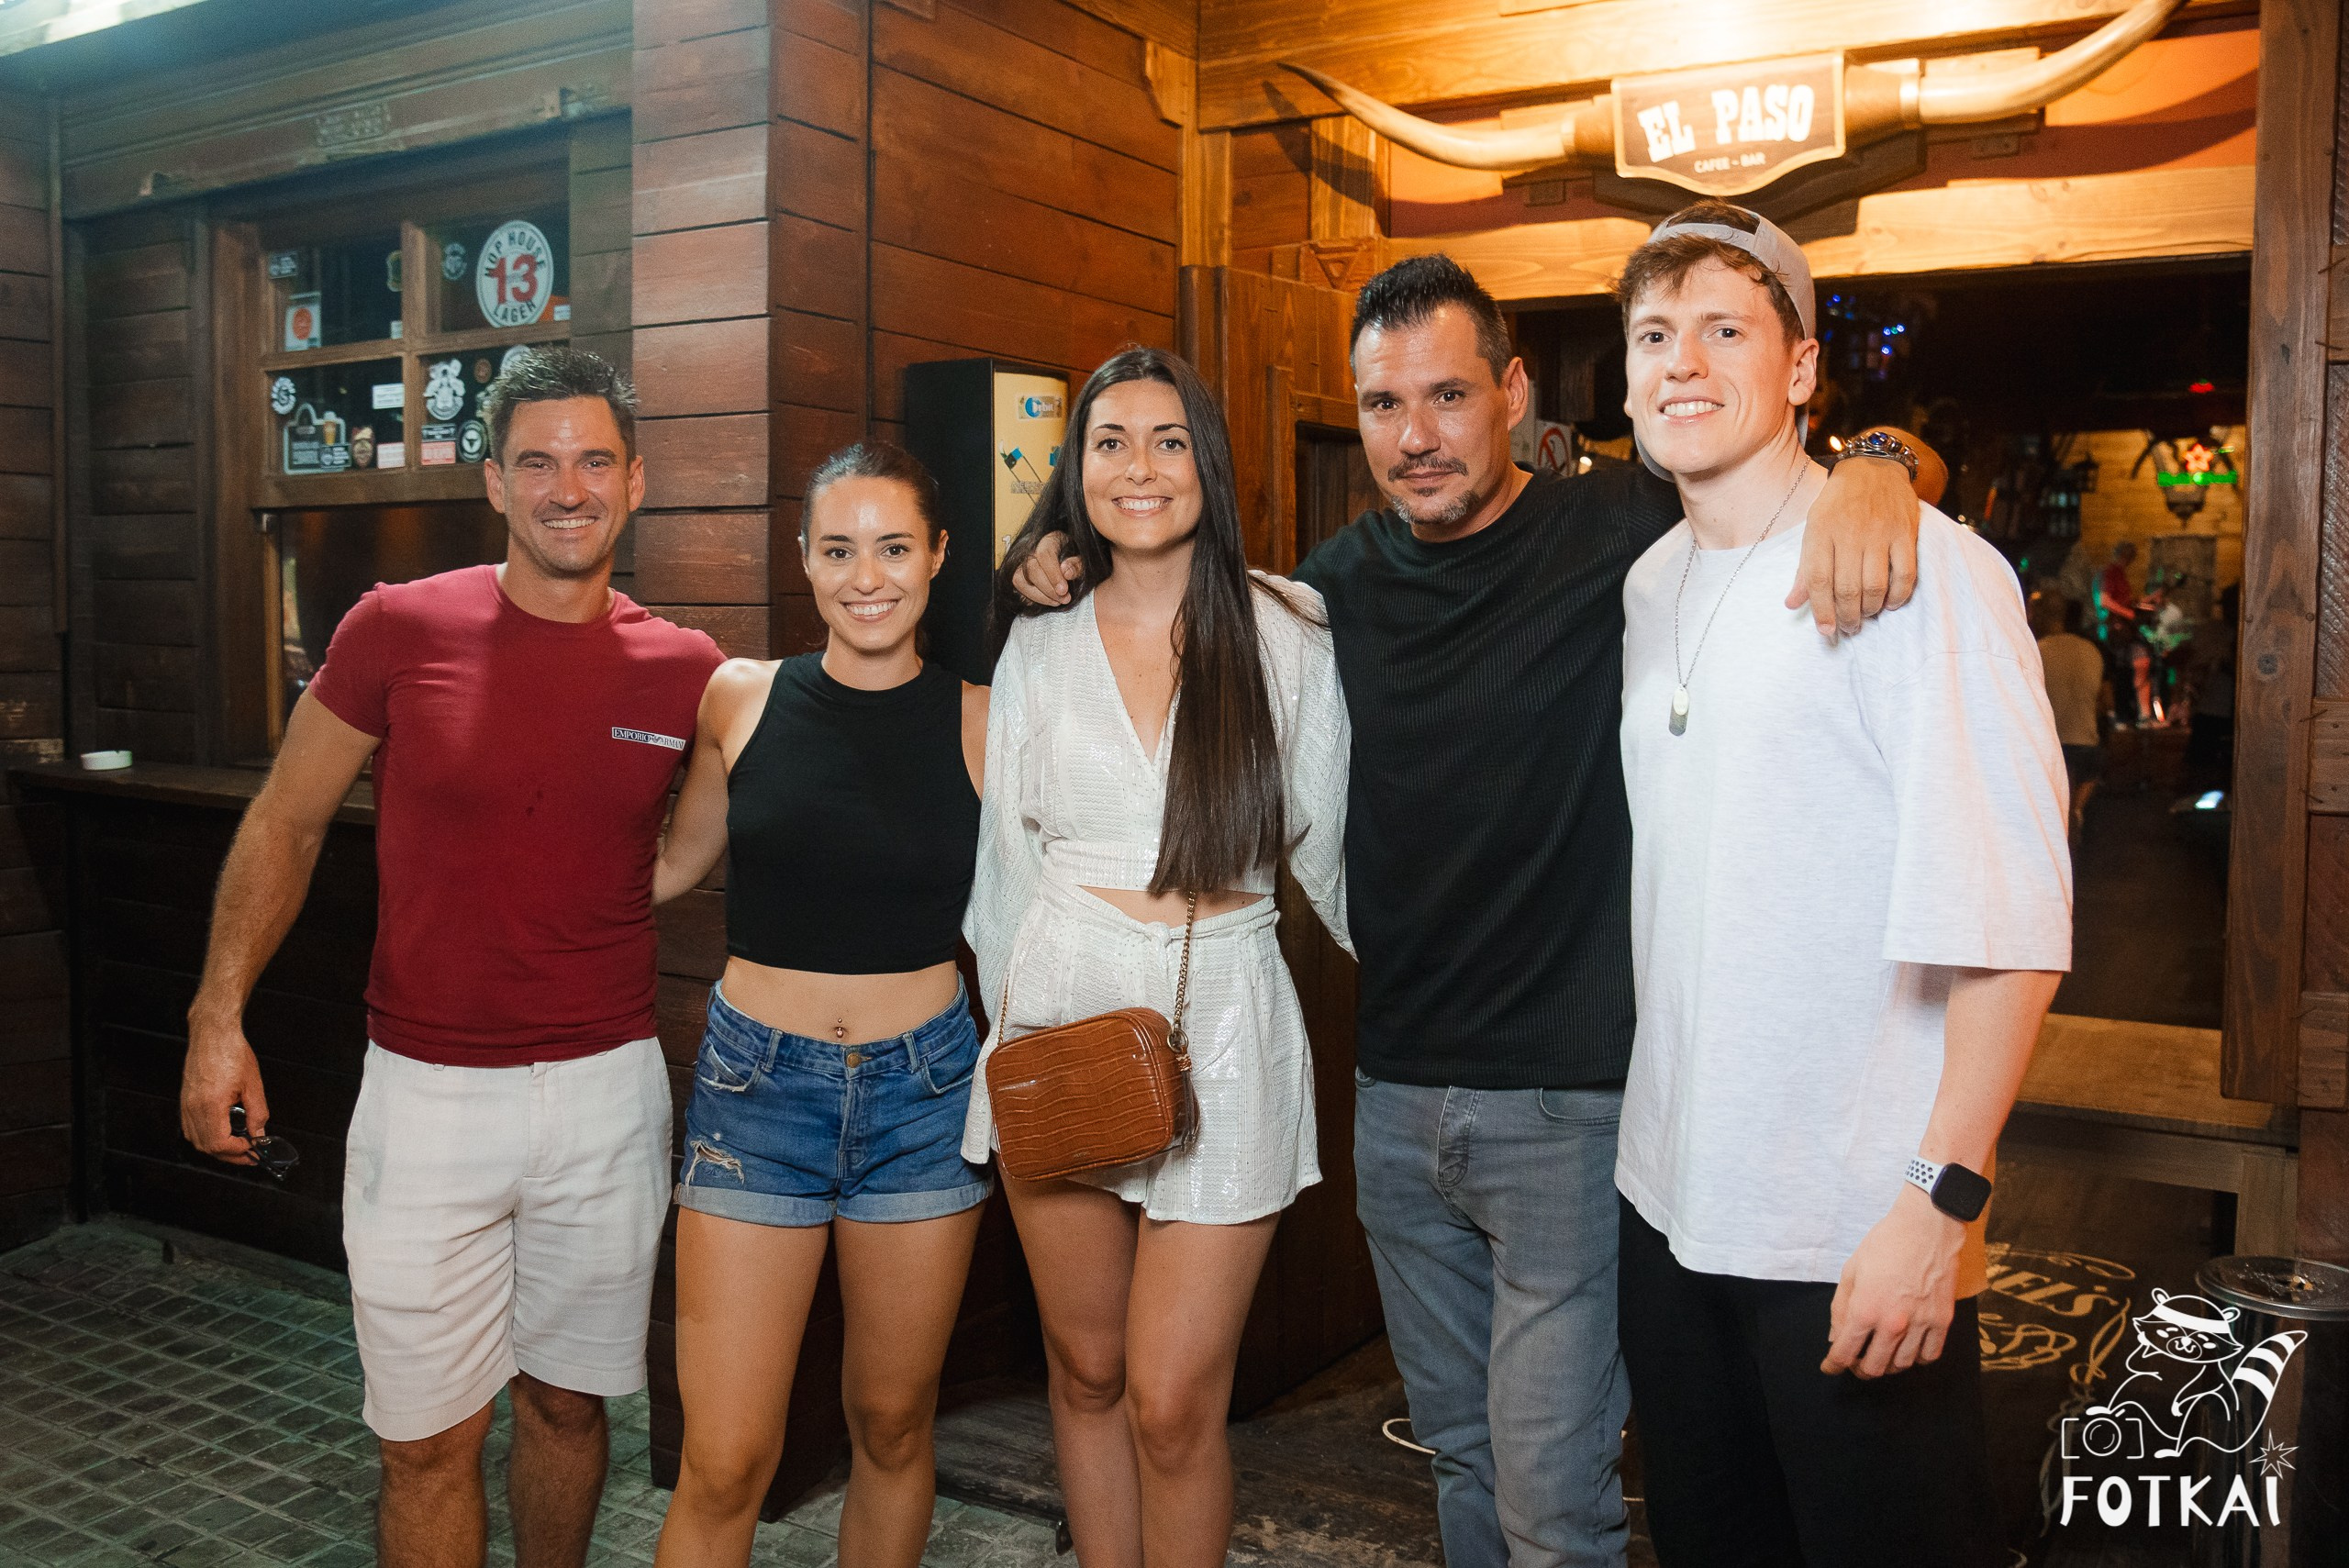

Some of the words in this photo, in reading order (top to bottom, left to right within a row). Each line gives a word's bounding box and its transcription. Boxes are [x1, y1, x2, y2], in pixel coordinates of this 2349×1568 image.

[1637, 101, 1696, 162] EL
[1711, 84, 1814, 142] PASO
[1740, 151, 1766, 168] BAR
[484, 240, 503, 277] HOP
[487, 254, 539, 305] 13
[495, 301, 536, 322] LAGER
[615, 729, 651, 742] EMPORIO
